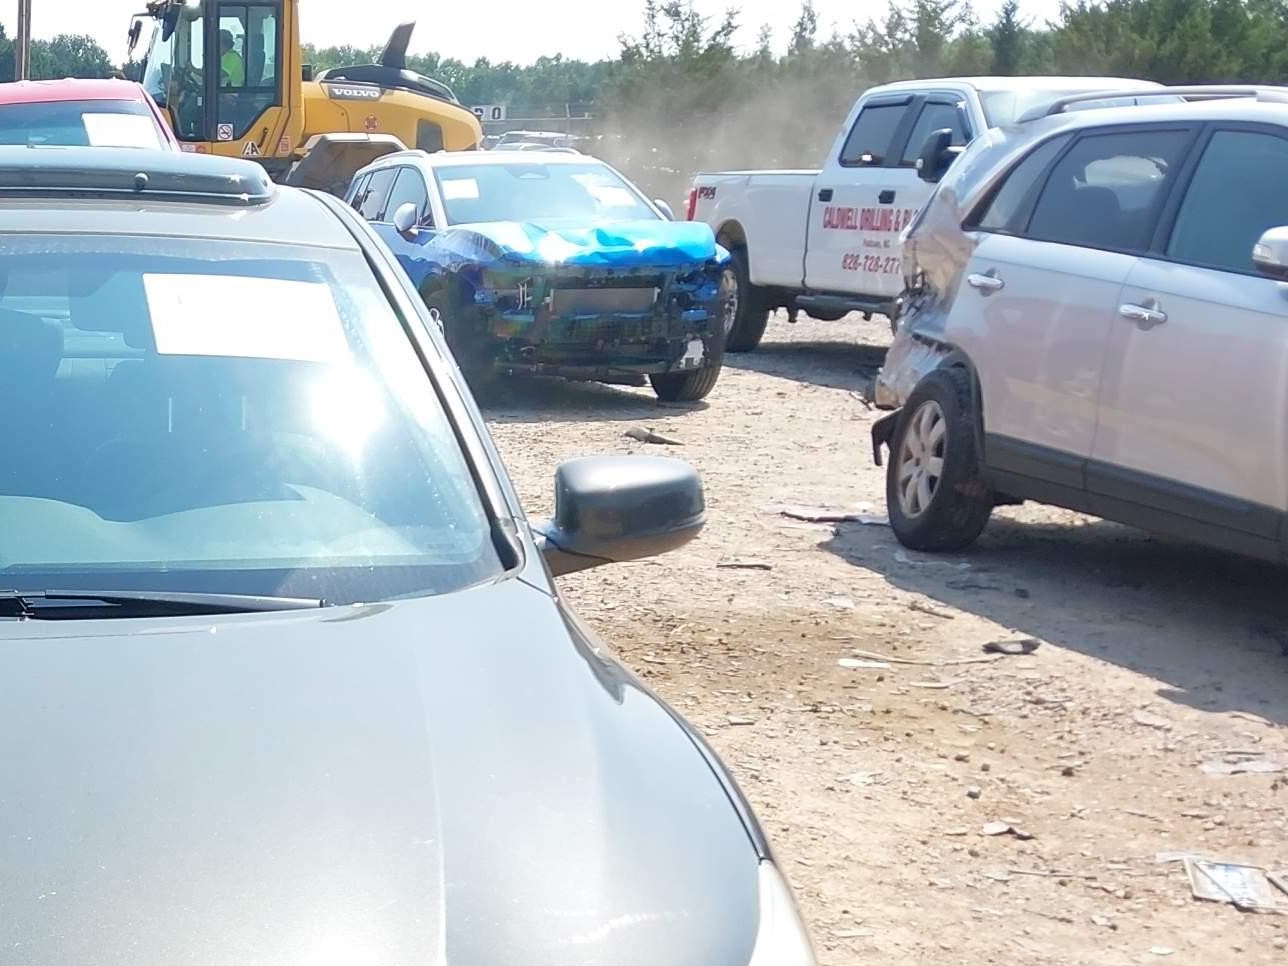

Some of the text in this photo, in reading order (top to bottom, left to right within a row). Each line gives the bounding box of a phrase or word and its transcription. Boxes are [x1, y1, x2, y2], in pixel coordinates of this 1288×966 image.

[332, 88, 379, 97] VOLVO
[823, 206, 859, 230] CALDWELL
[860, 207, 894, 232] DRILLING
[842, 253, 902, 274] 828-728-277
